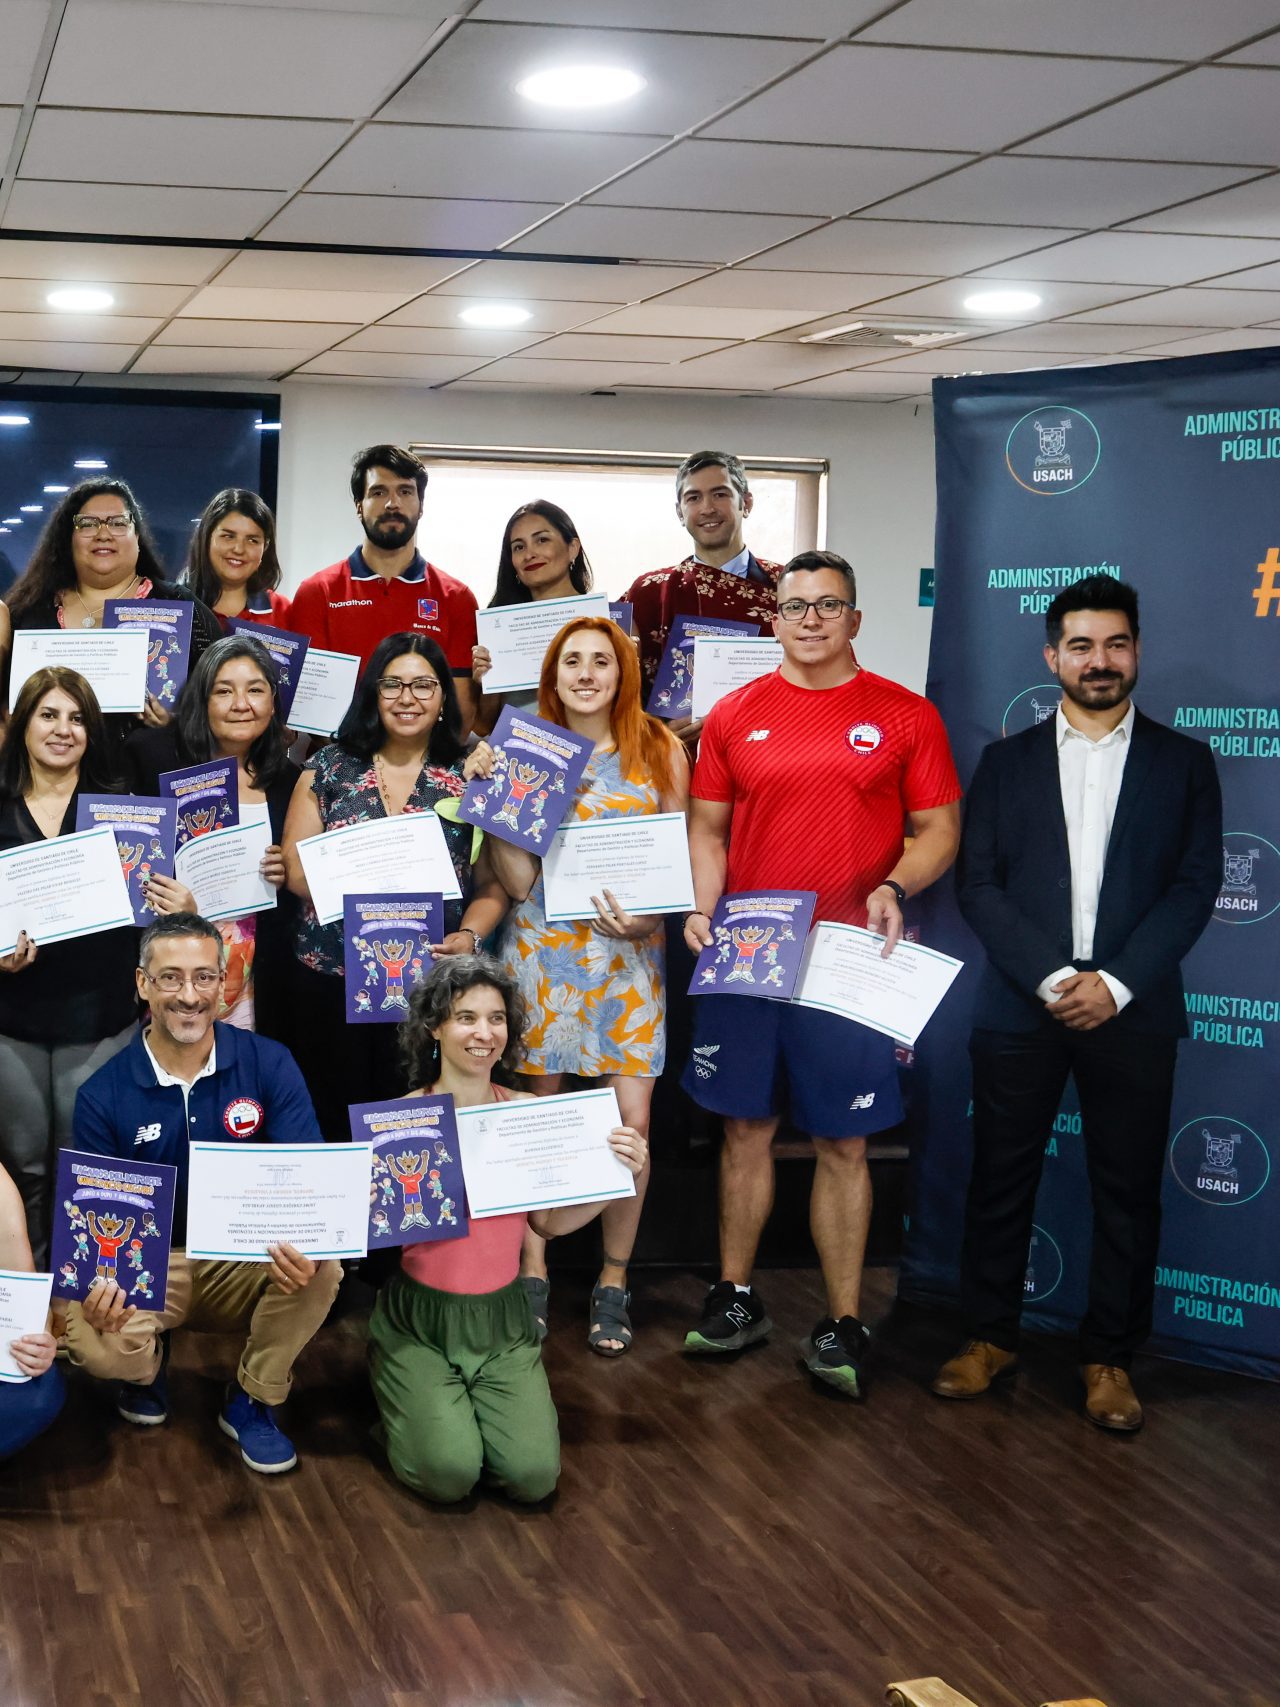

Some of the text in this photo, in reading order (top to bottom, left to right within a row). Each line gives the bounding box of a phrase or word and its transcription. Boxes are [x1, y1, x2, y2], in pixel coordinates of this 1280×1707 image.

[1184, 408, 1280, 436] ADMINISTR
[1033, 468, 1073, 482] USACH
[329, 599, 373, 609] marathon
[1174, 707, 1280, 729] ADMINISTRA
[1209, 731, 1280, 757] PÚBLICA
[1215, 896, 1258, 911] USACH
[1184, 992, 1280, 1022] MINISTRACI
[1193, 1017, 1264, 1048] PÚBLICA
[1197, 1177, 1239, 1194] USACH
[1154, 1265, 1280, 1309] DMINISTRACIÓN
[1174, 1294, 1244, 1328] PÚBLICA
